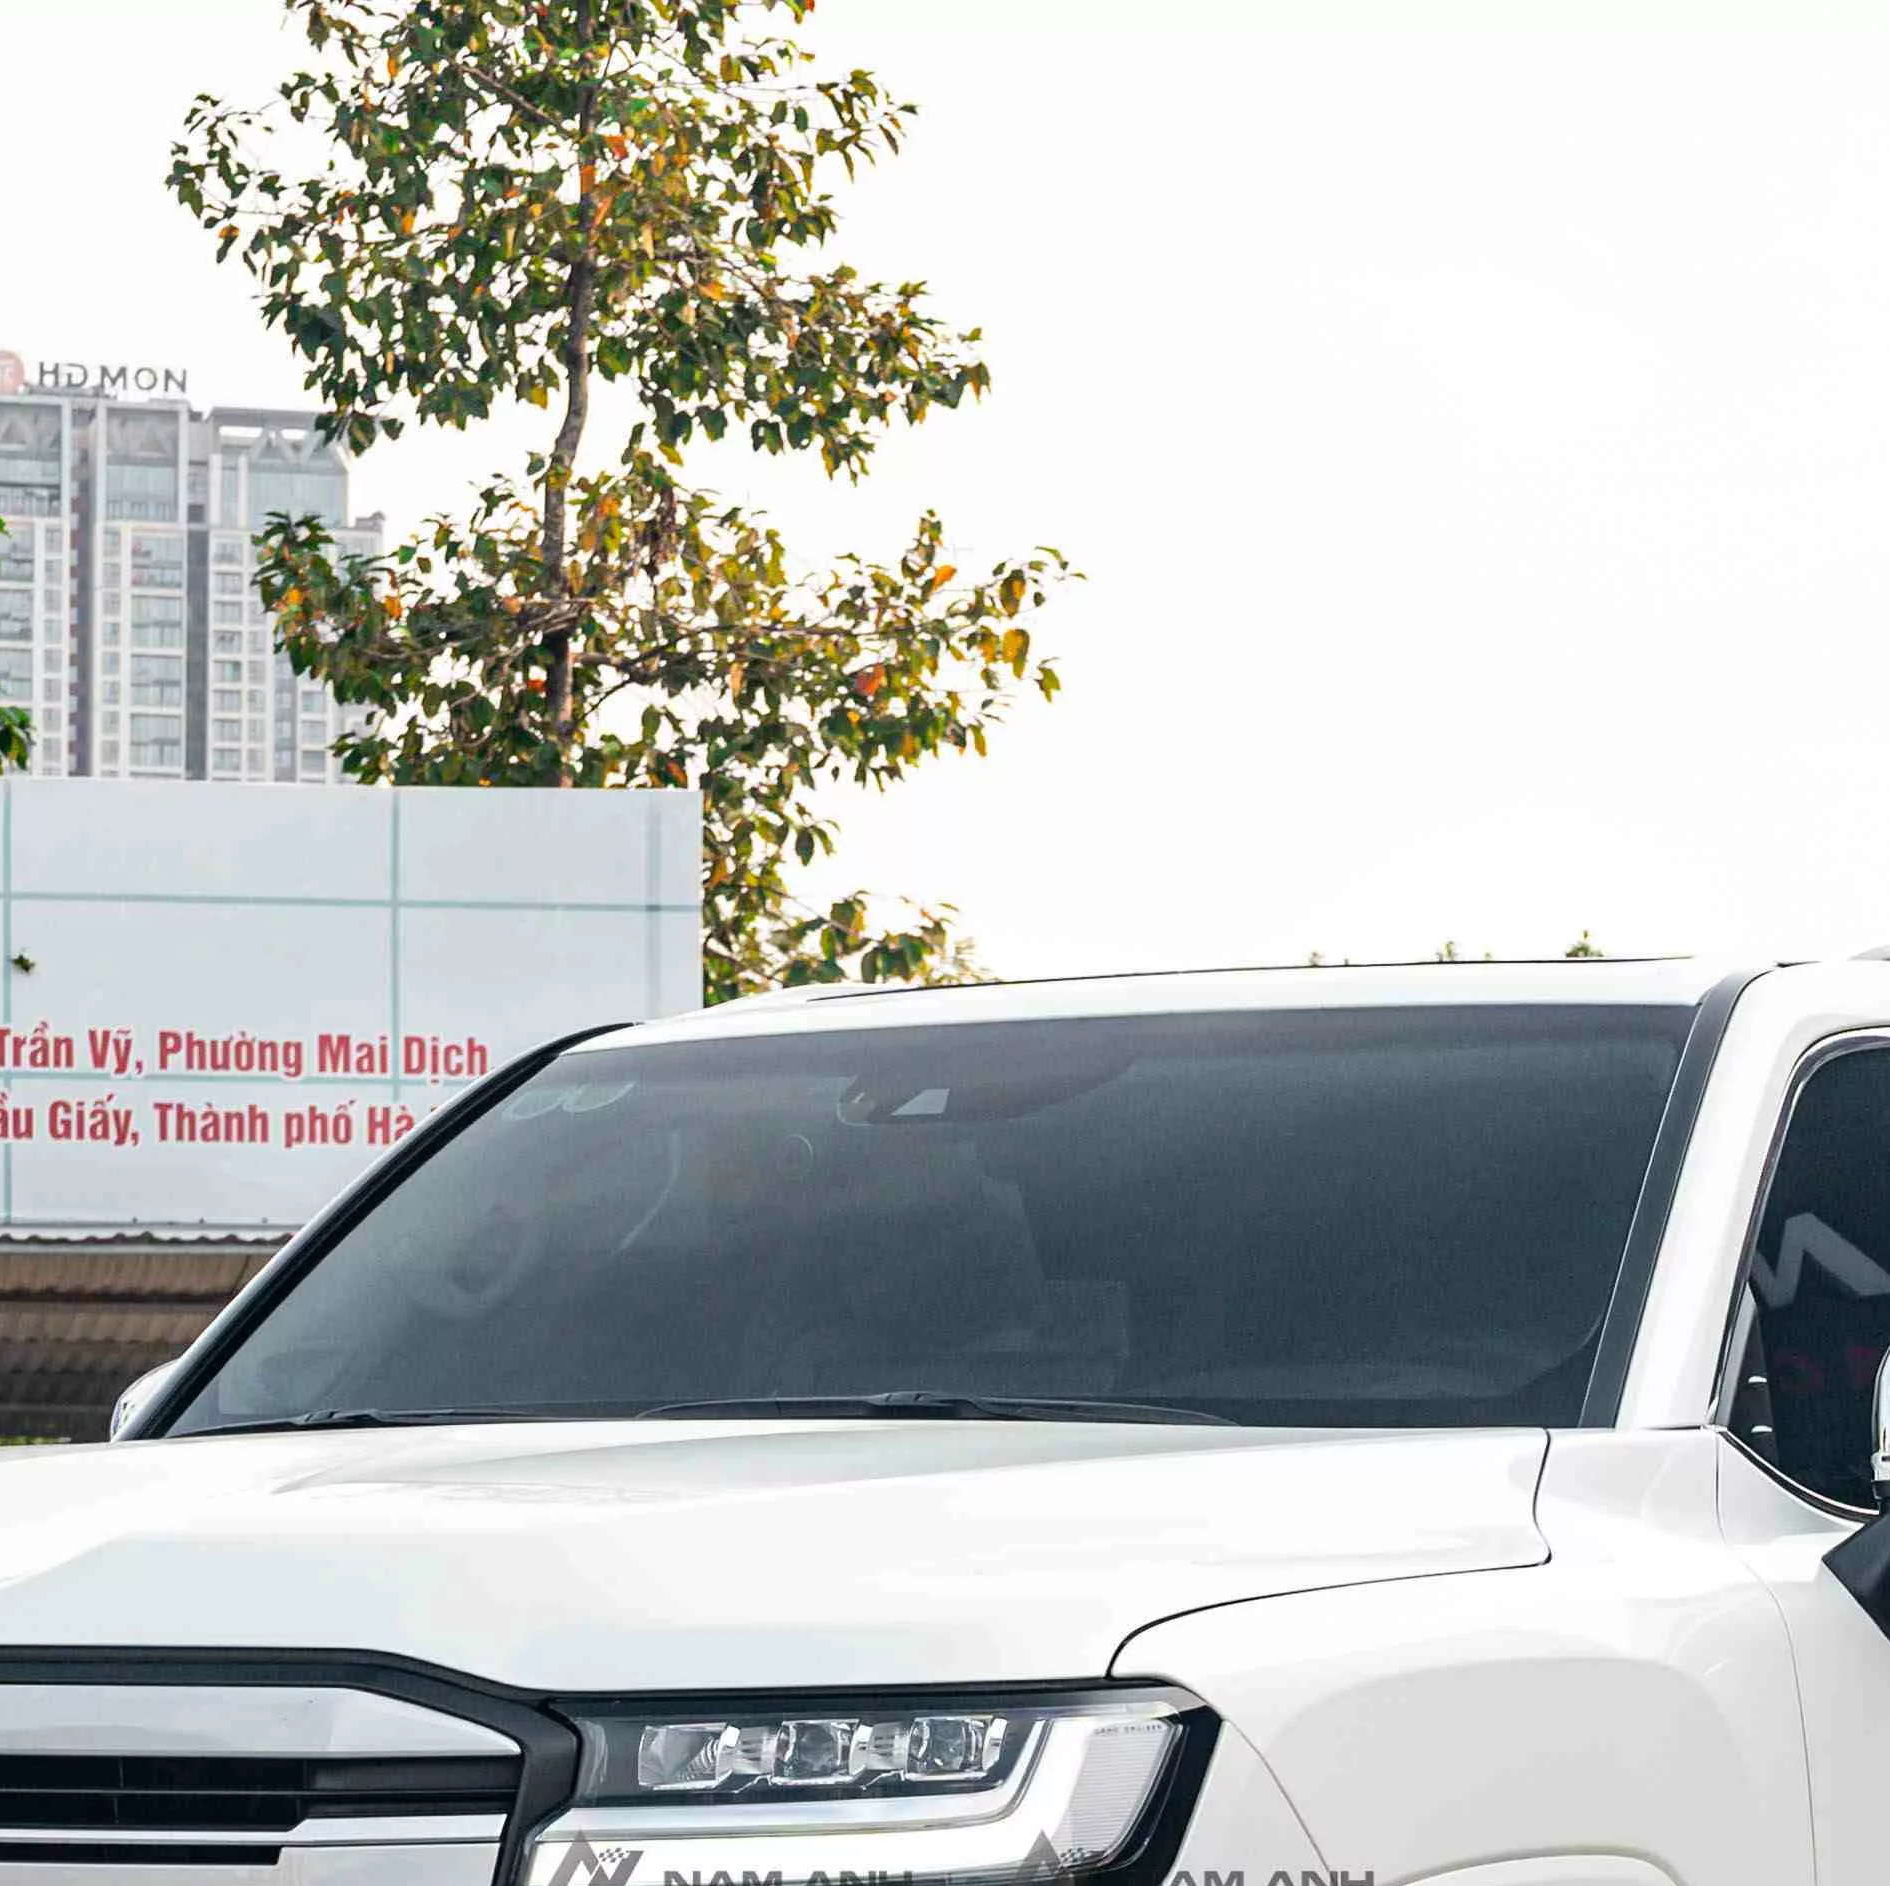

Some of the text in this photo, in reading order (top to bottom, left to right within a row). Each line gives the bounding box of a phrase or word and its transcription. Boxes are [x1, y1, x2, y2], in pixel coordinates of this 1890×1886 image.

[99, 365, 188, 393] MON
[88, 1028, 144, 1075] Vỹ,
[158, 1030, 303, 1079] Phường
[317, 1034, 391, 1075] Mai
[403, 1035, 489, 1083] Dịch
[49, 1092, 140, 1147] Giấy,
[152, 1101, 270, 1144] Thành
[283, 1099, 358, 1149] phố
